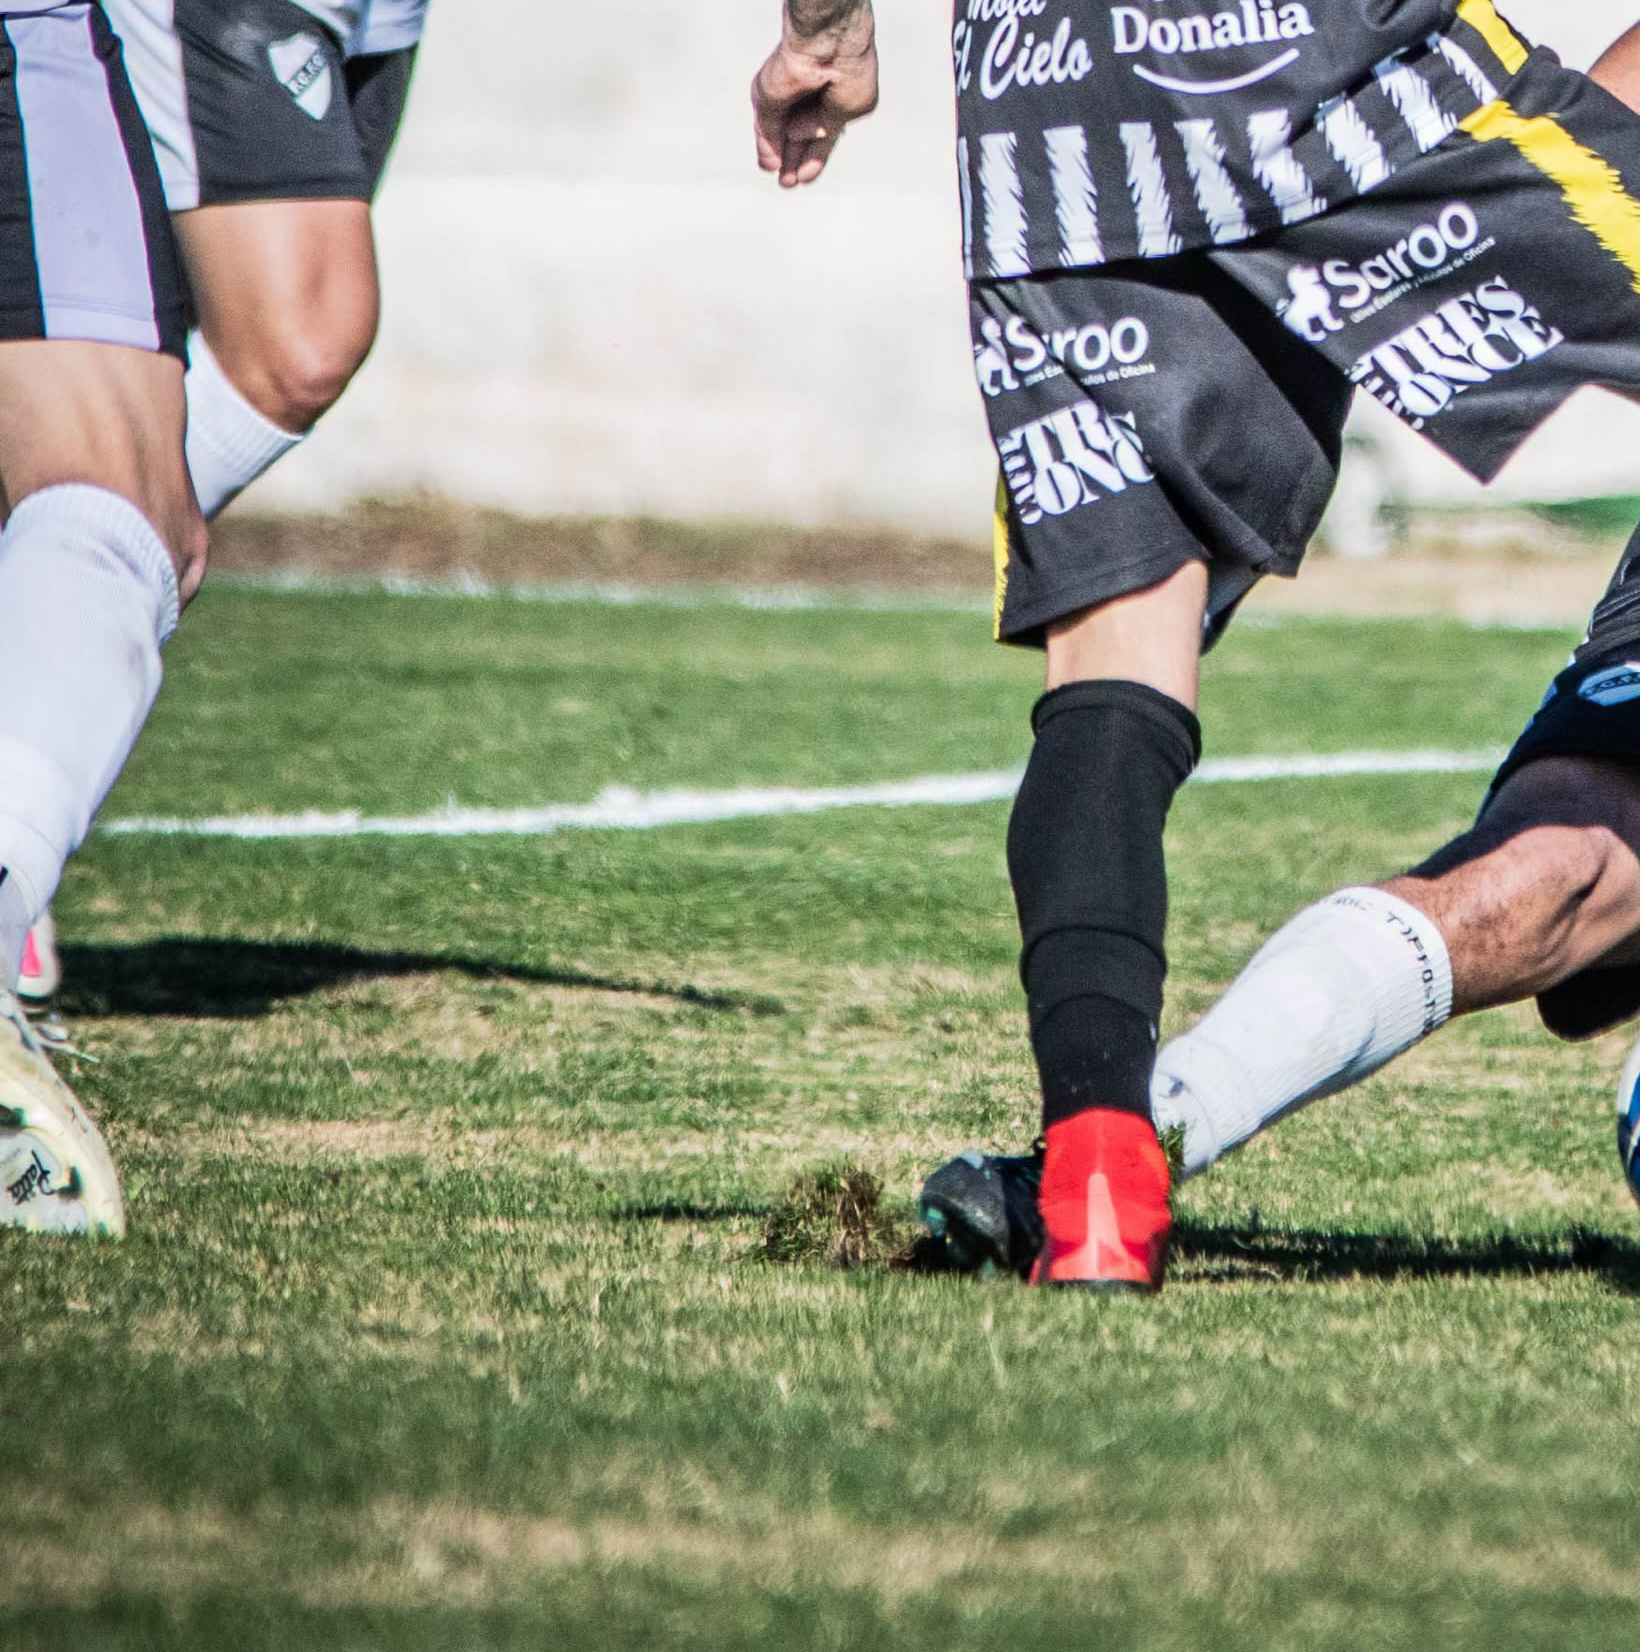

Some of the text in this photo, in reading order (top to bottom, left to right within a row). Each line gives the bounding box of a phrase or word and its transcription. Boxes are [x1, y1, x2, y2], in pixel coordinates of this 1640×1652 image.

[979, 16, 1093, 100] Cielo
[1321, 200, 1479, 309] Saroo
[1005, 314, 1149, 372] Sroo
